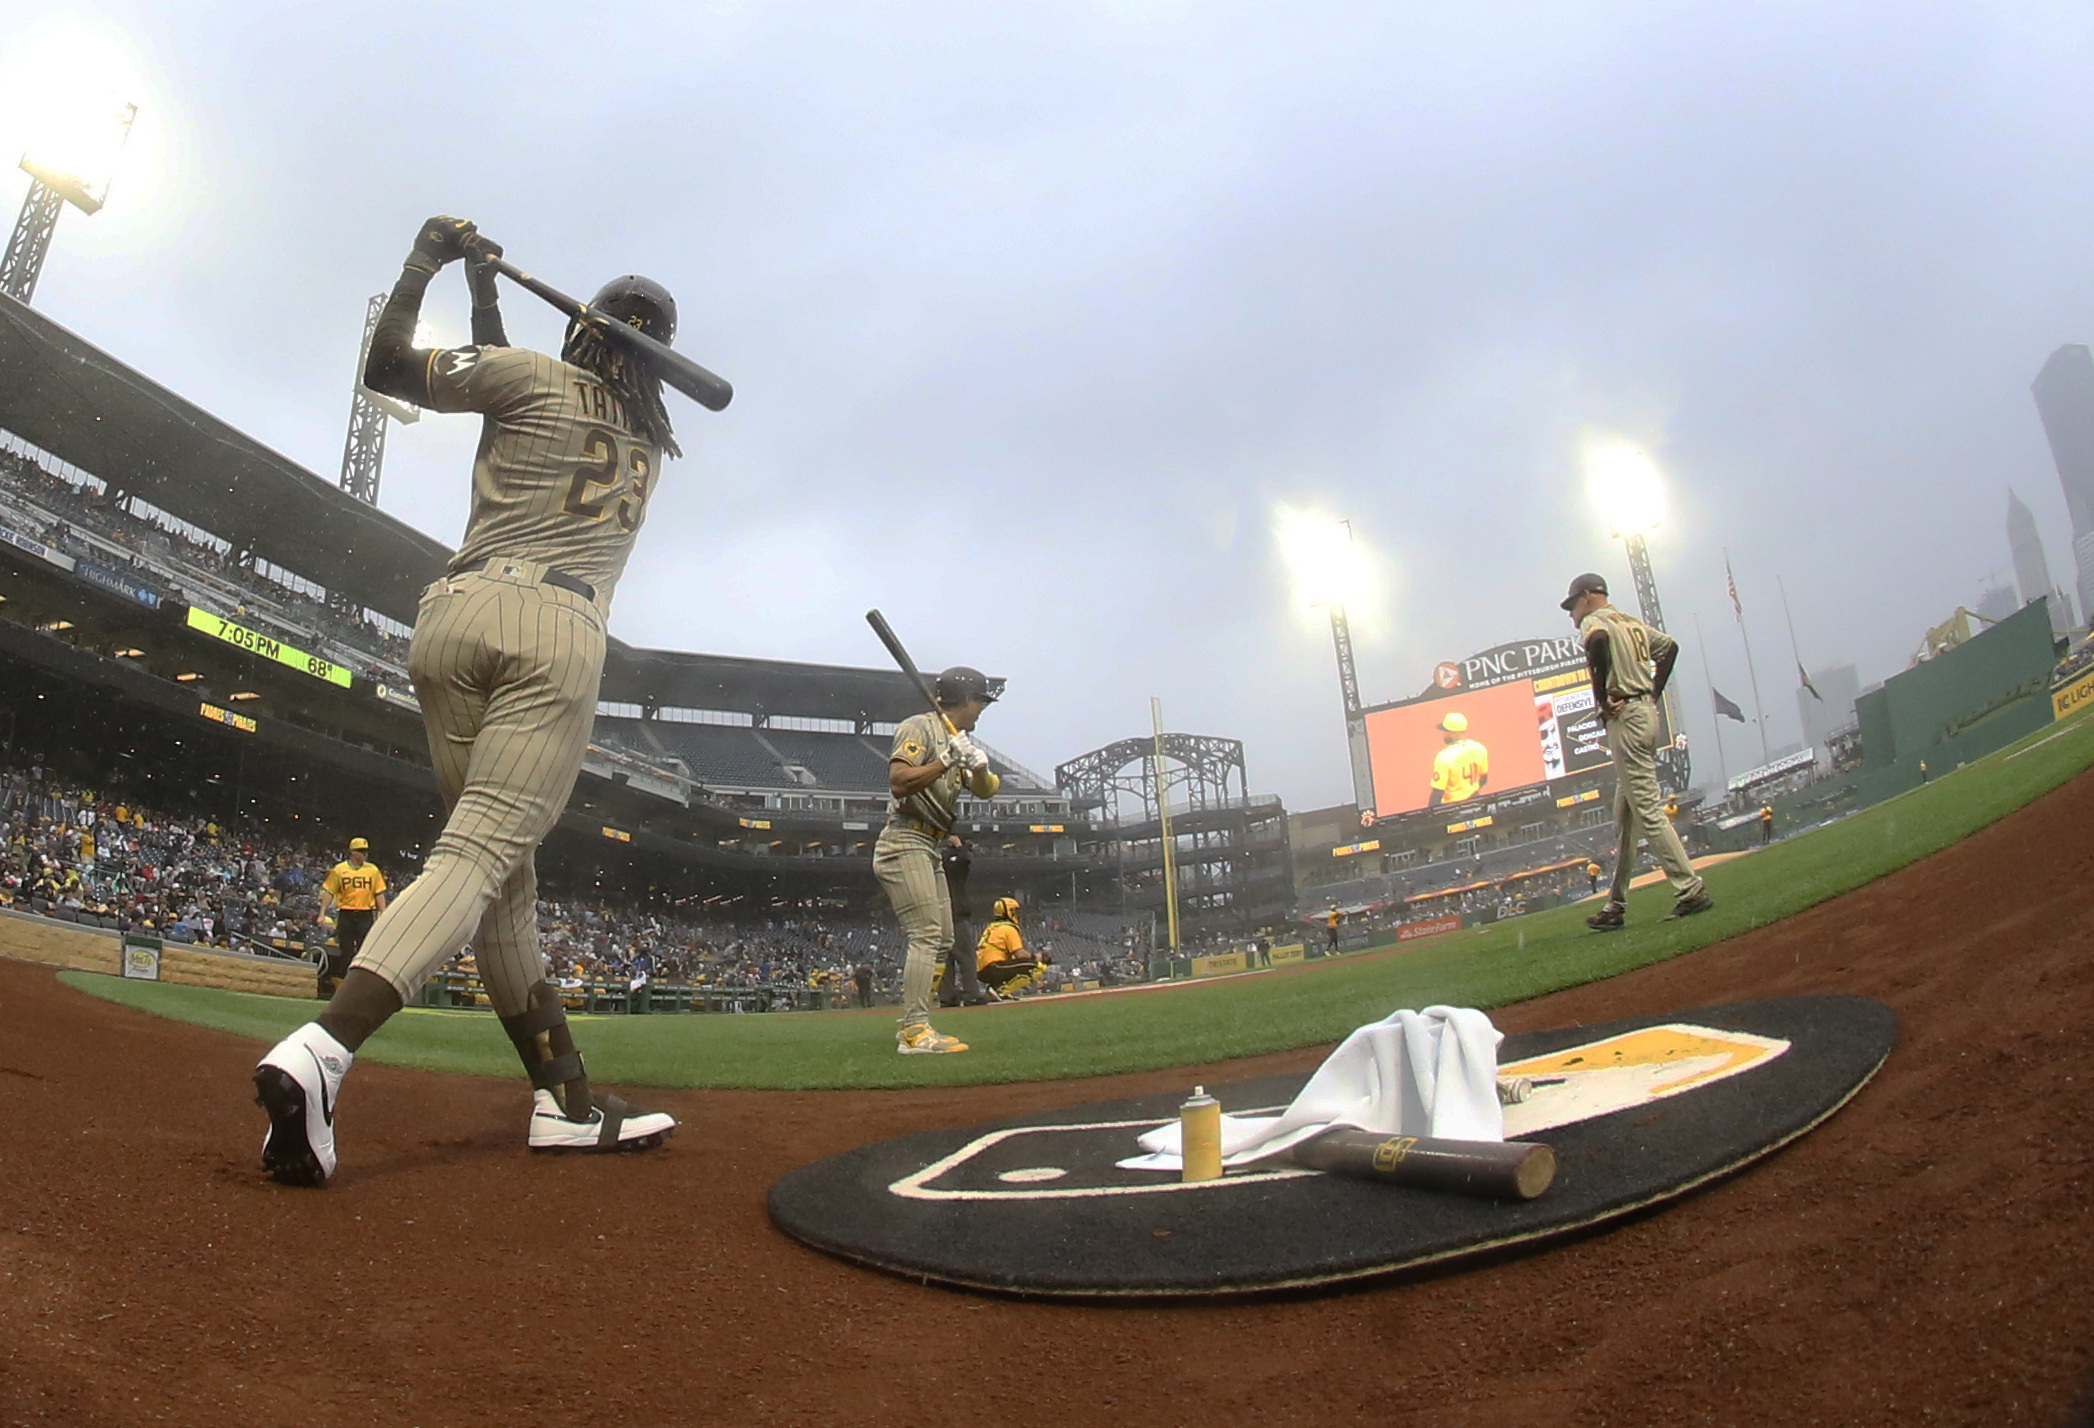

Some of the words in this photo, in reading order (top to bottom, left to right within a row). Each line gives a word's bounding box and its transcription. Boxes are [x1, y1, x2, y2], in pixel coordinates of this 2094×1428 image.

[628, 315, 643, 330] 23
[560, 428, 650, 533] 23
[218, 620, 254, 648] 7:05
[256, 636, 280, 660] PM
[307, 657, 333, 677] 68°
[1626, 627, 1649, 662] 18
[1465, 650, 1519, 681] PNC
[1522, 635, 1586, 667] PARK
[1469, 680, 1490, 689] HOME
[1502, 674, 1516, 682] THE
[1517, 663, 1560, 679] PITTSBURGH
[1556, 697, 1593, 714] DEFENSIVE
[1462, 762, 1478, 785] 41
[341, 877, 372, 891] PGH
